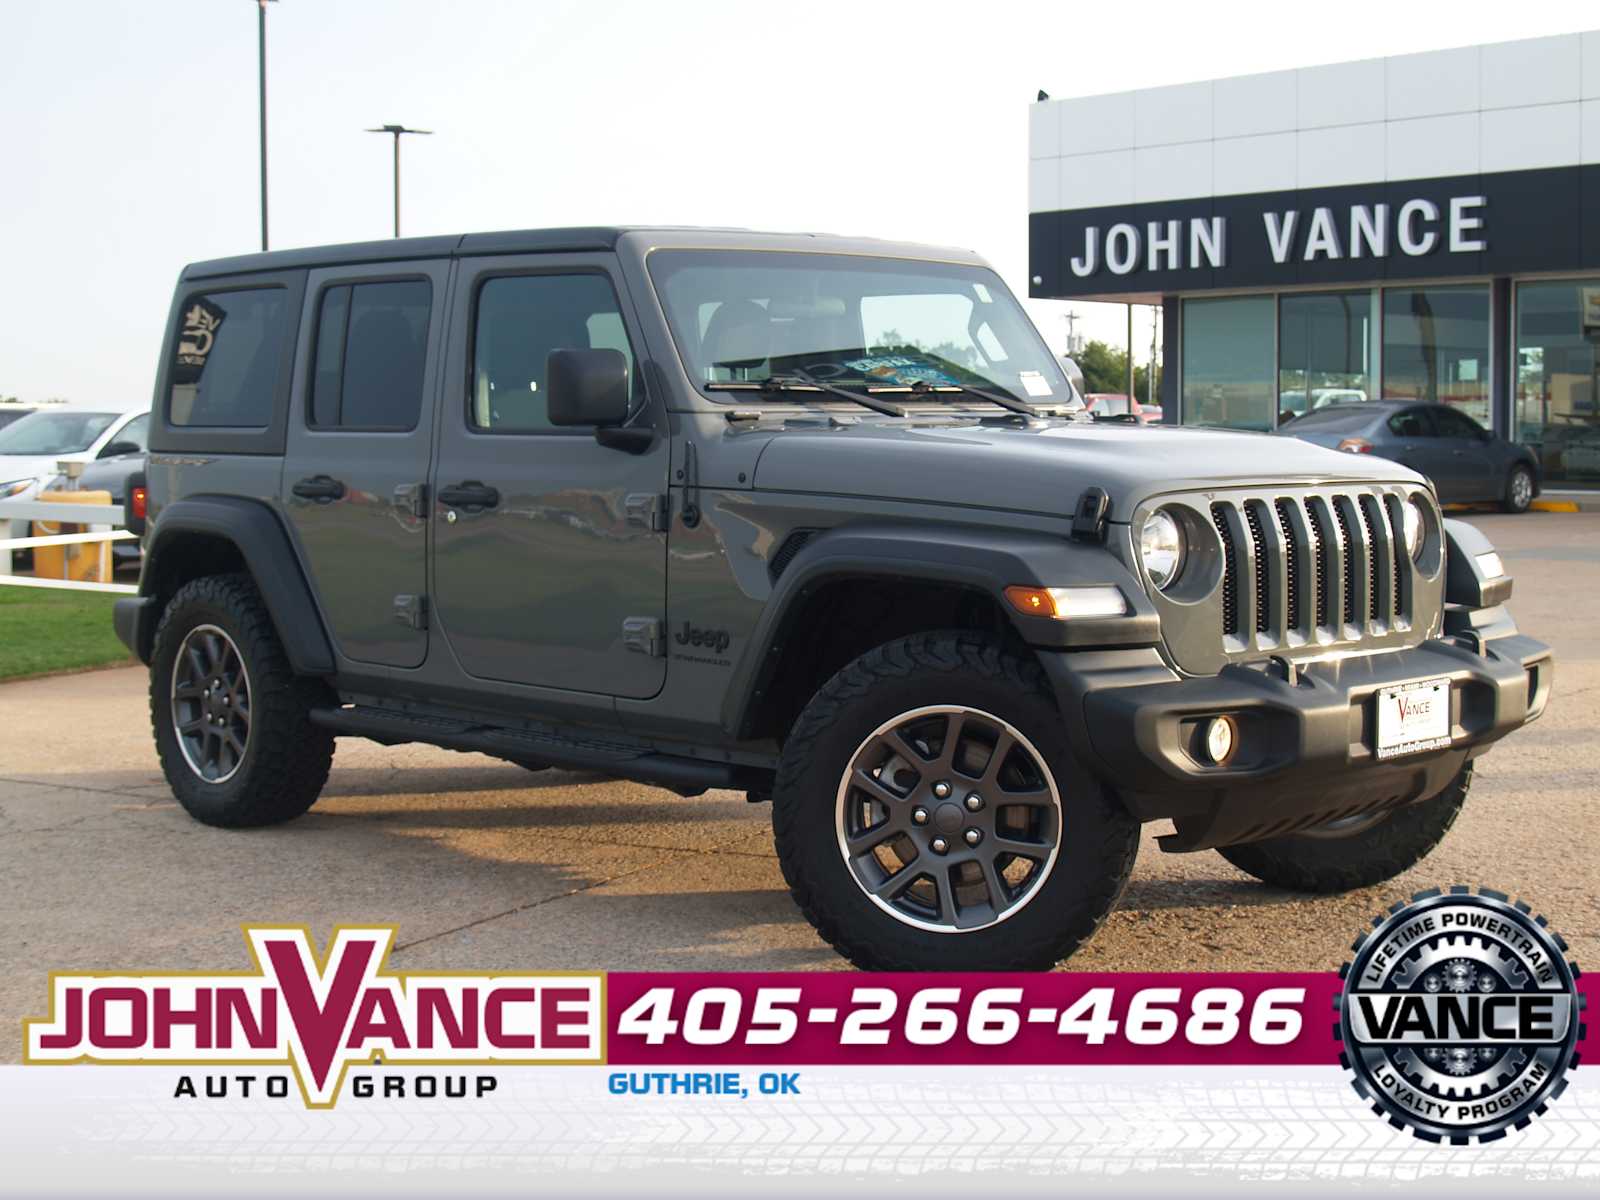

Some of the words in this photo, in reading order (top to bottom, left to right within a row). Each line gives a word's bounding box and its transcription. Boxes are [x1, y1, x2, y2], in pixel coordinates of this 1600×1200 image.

[1070, 216, 1226, 278] JOHN
[1263, 196, 1487, 263] VANCE
[675, 620, 730, 653] Jeep
